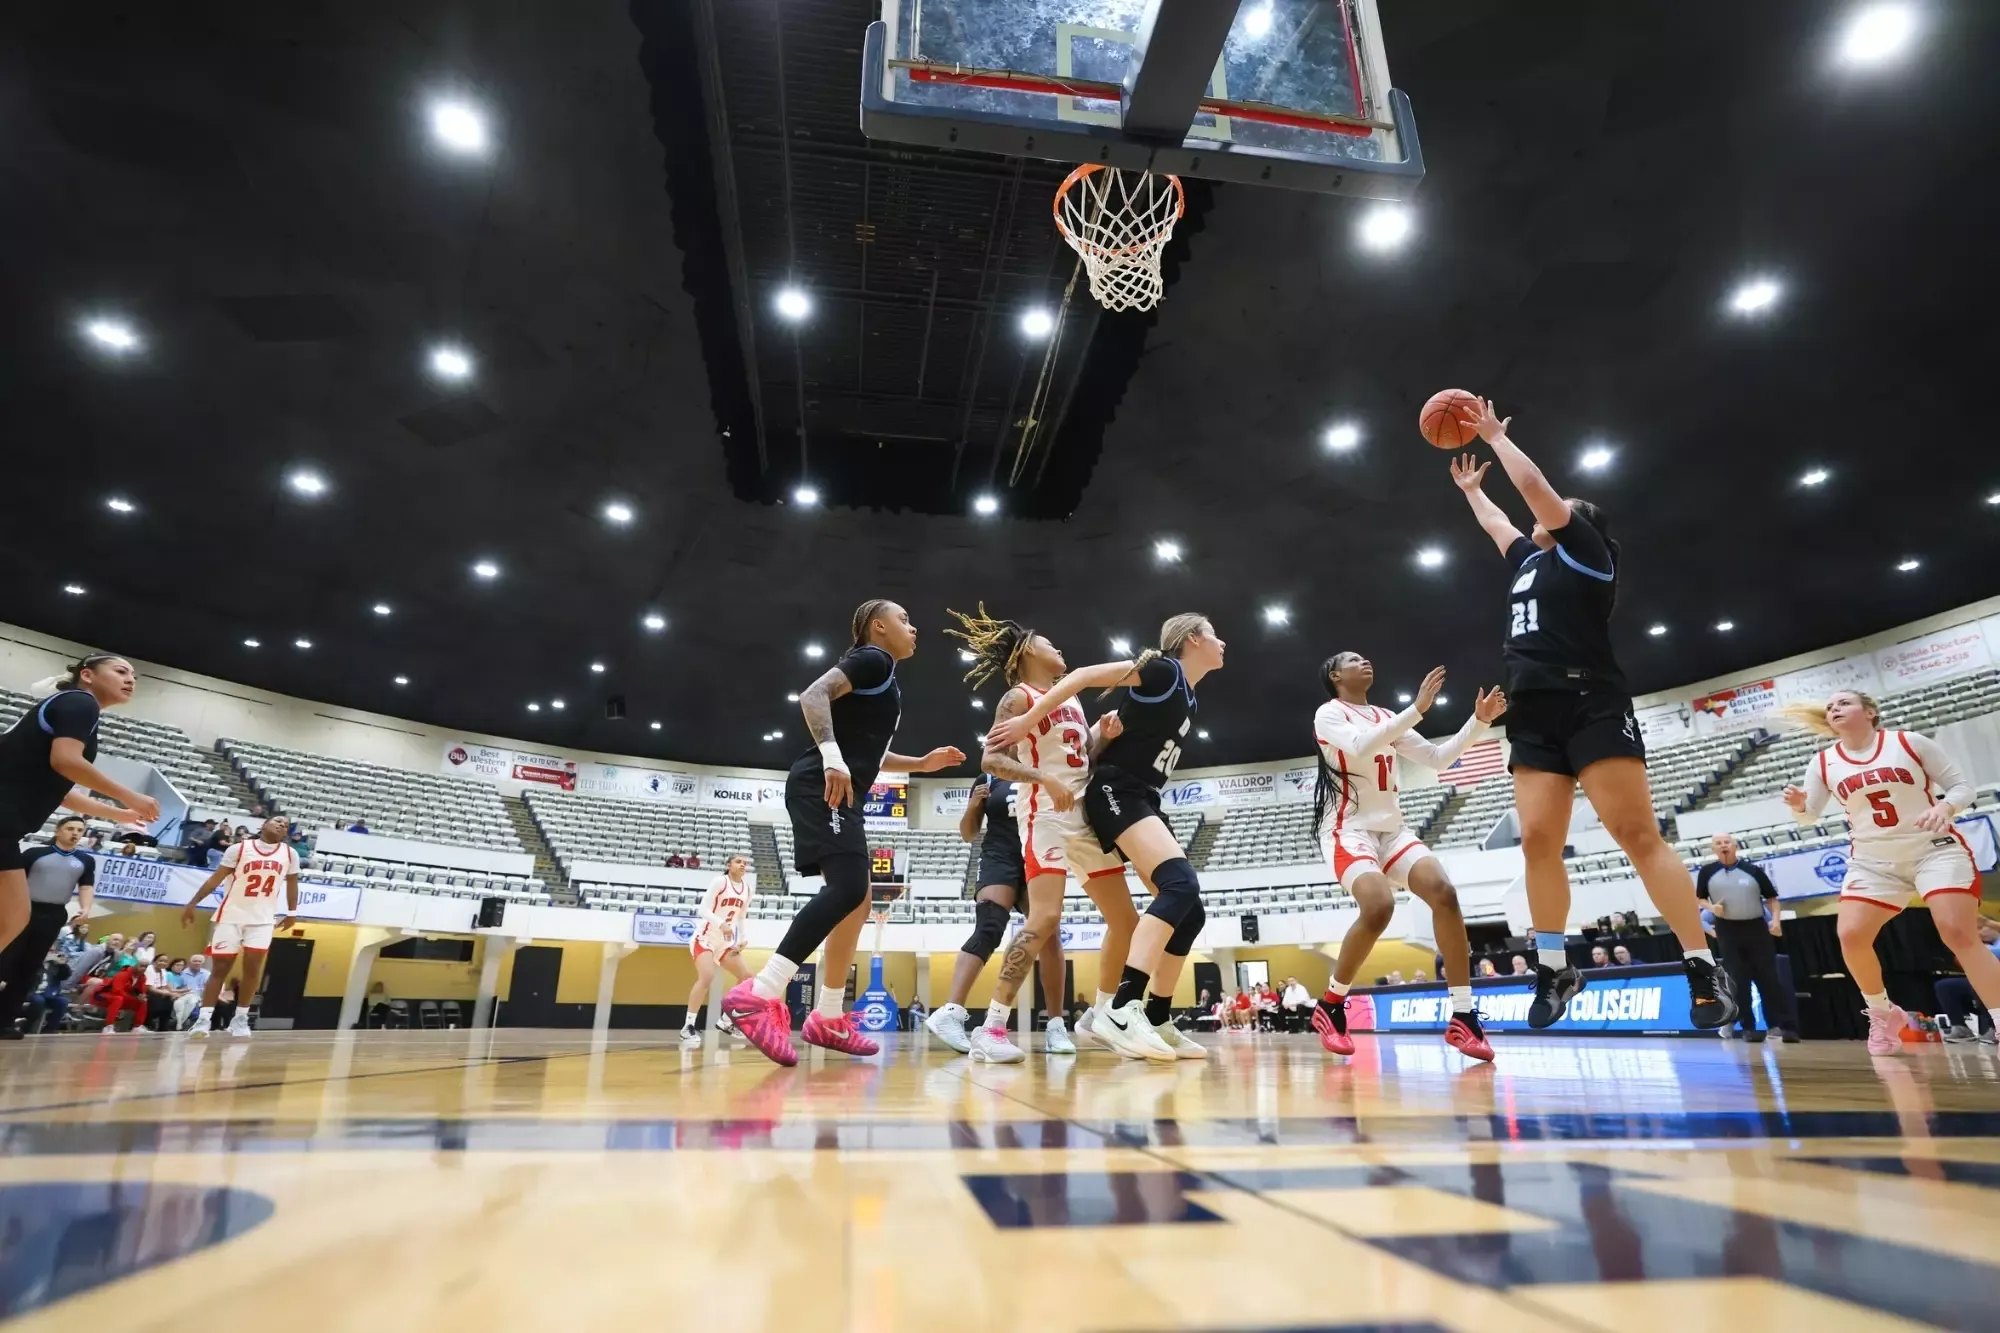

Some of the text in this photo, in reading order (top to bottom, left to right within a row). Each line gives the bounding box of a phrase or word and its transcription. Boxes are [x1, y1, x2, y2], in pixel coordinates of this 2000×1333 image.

[1511, 599, 1539, 638] 21
[1899, 644, 1929, 661] Smile
[1930, 633, 1980, 653] Doctors
[1729, 692, 1775, 709] GOLDSTAR
[480, 749, 500, 759] Best
[1063, 729, 1084, 768] 3
[470, 755, 506, 767] Western
[1152, 739, 1181, 777] 20
[475, 764, 499, 774] PLUS
[1218, 775, 1273, 789] WALDROP
[1836, 767, 1915, 801] OWENS
[714, 789, 753, 801] KOHLER
[898, 788, 907, 799] 5
[1161, 786, 1202, 805] VIP
[892, 805, 905, 817] 03
[1865, 789, 1899, 828] 5
[103, 859, 126, 875] GET
[126, 862, 165, 880] READY
[872, 858, 891, 873] 23
[95, 882, 167, 900] CHAMPIONSHIP
[244, 874, 275, 897] 24
[297, 891, 326, 905] JCAA
[1390, 997, 1440, 1023] WELCOME
[1570, 987, 1662, 1022] COLISEUM
